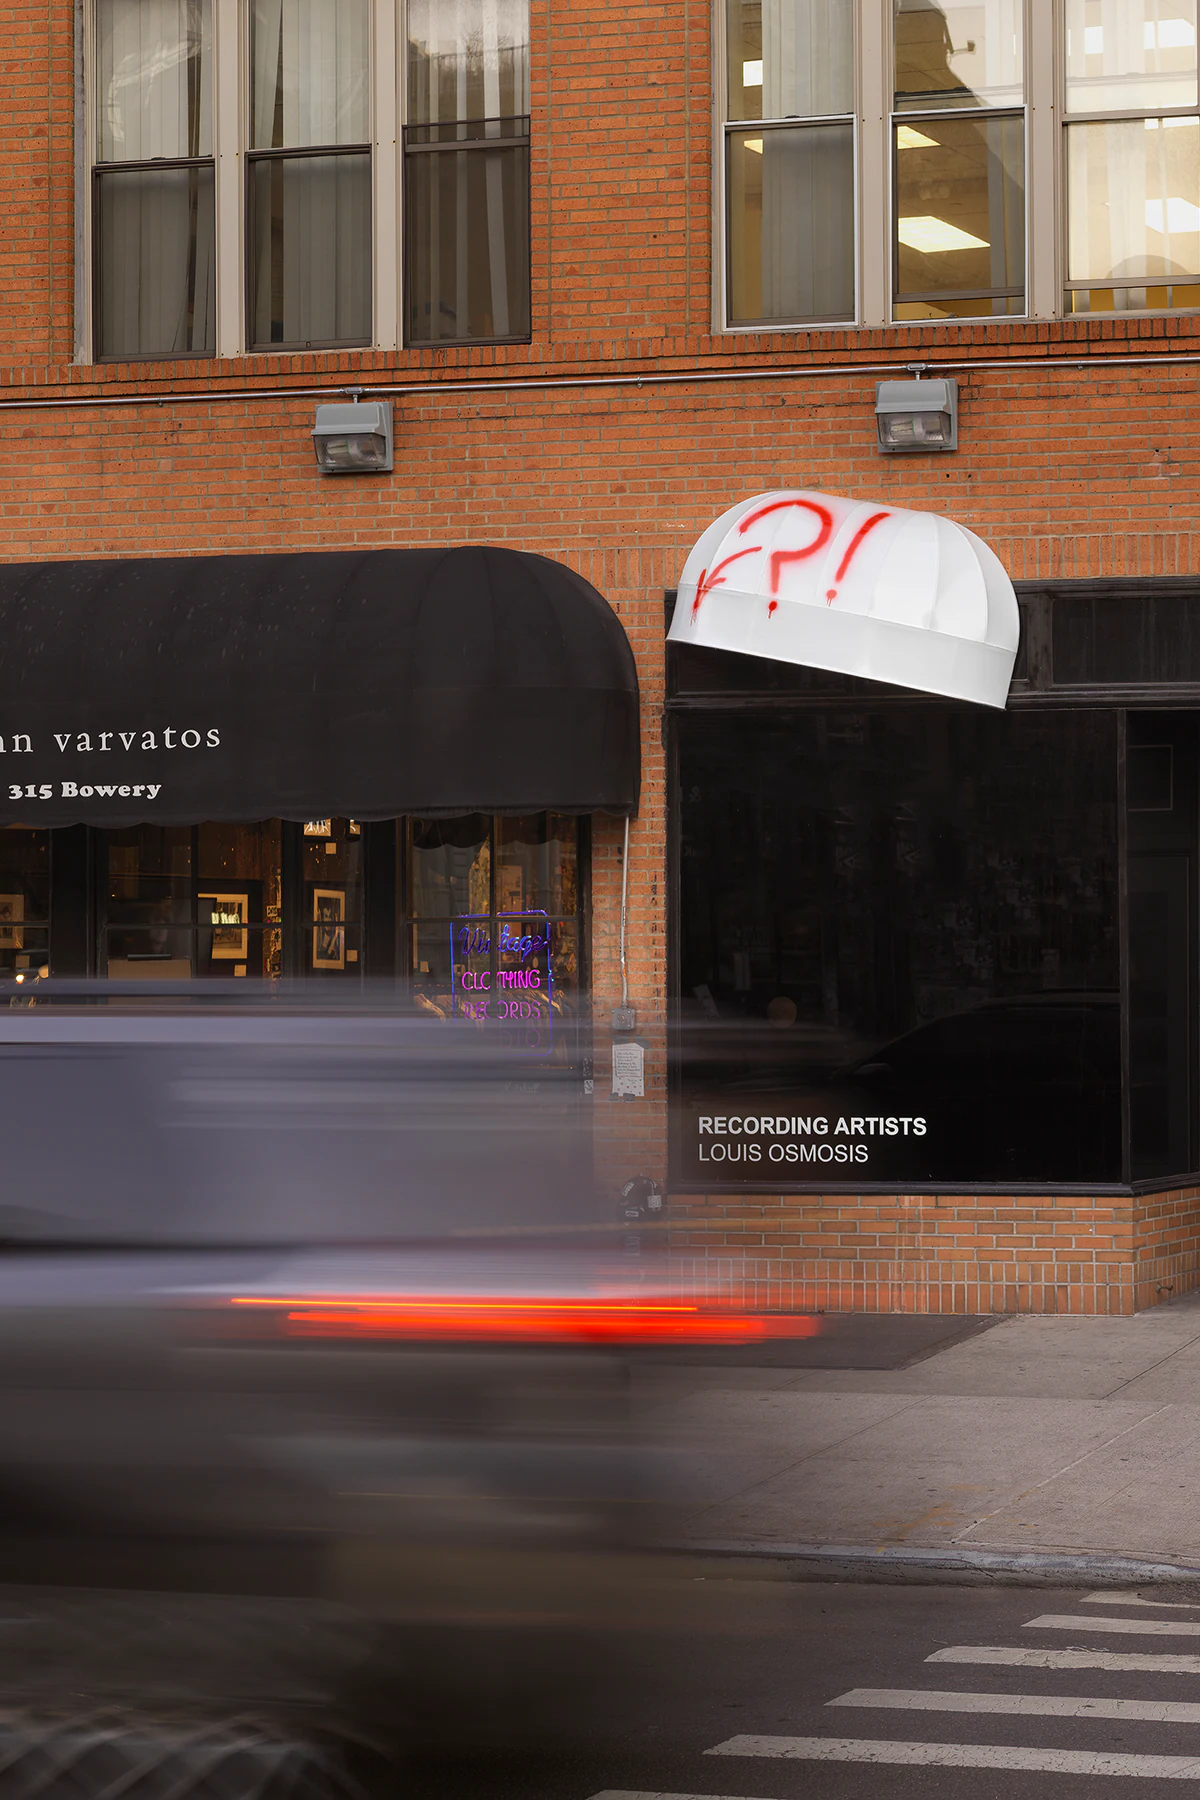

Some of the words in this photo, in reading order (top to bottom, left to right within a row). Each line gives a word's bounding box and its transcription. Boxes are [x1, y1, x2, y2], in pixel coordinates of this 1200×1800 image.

[53, 726, 221, 753] varvatos
[8, 784, 53, 799] 315
[61, 781, 162, 799] Bowery
[698, 1116, 829, 1135] RECORDING
[833, 1117, 927, 1136] ARTISTS
[699, 1143, 762, 1162] LOUIS
[768, 1144, 869, 1163] OSMOSIS
